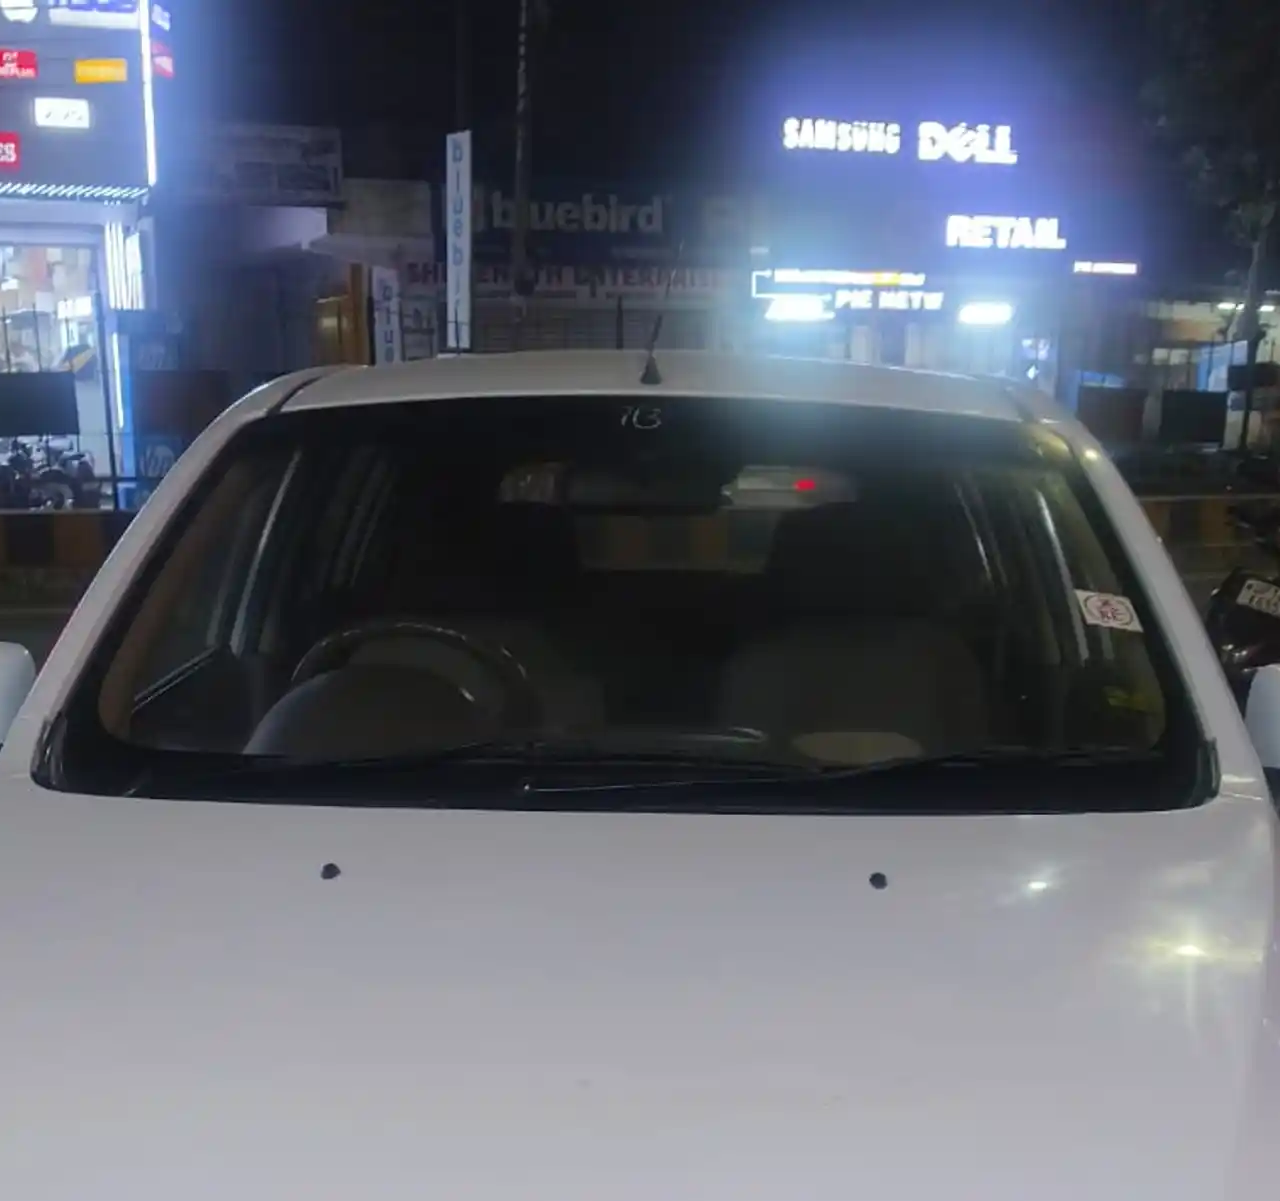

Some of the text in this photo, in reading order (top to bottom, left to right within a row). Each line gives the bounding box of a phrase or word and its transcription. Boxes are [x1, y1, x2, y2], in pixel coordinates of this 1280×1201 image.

[783, 117, 1018, 164] SAMSUNG DELL
[946, 214, 1067, 250] RETAIL
